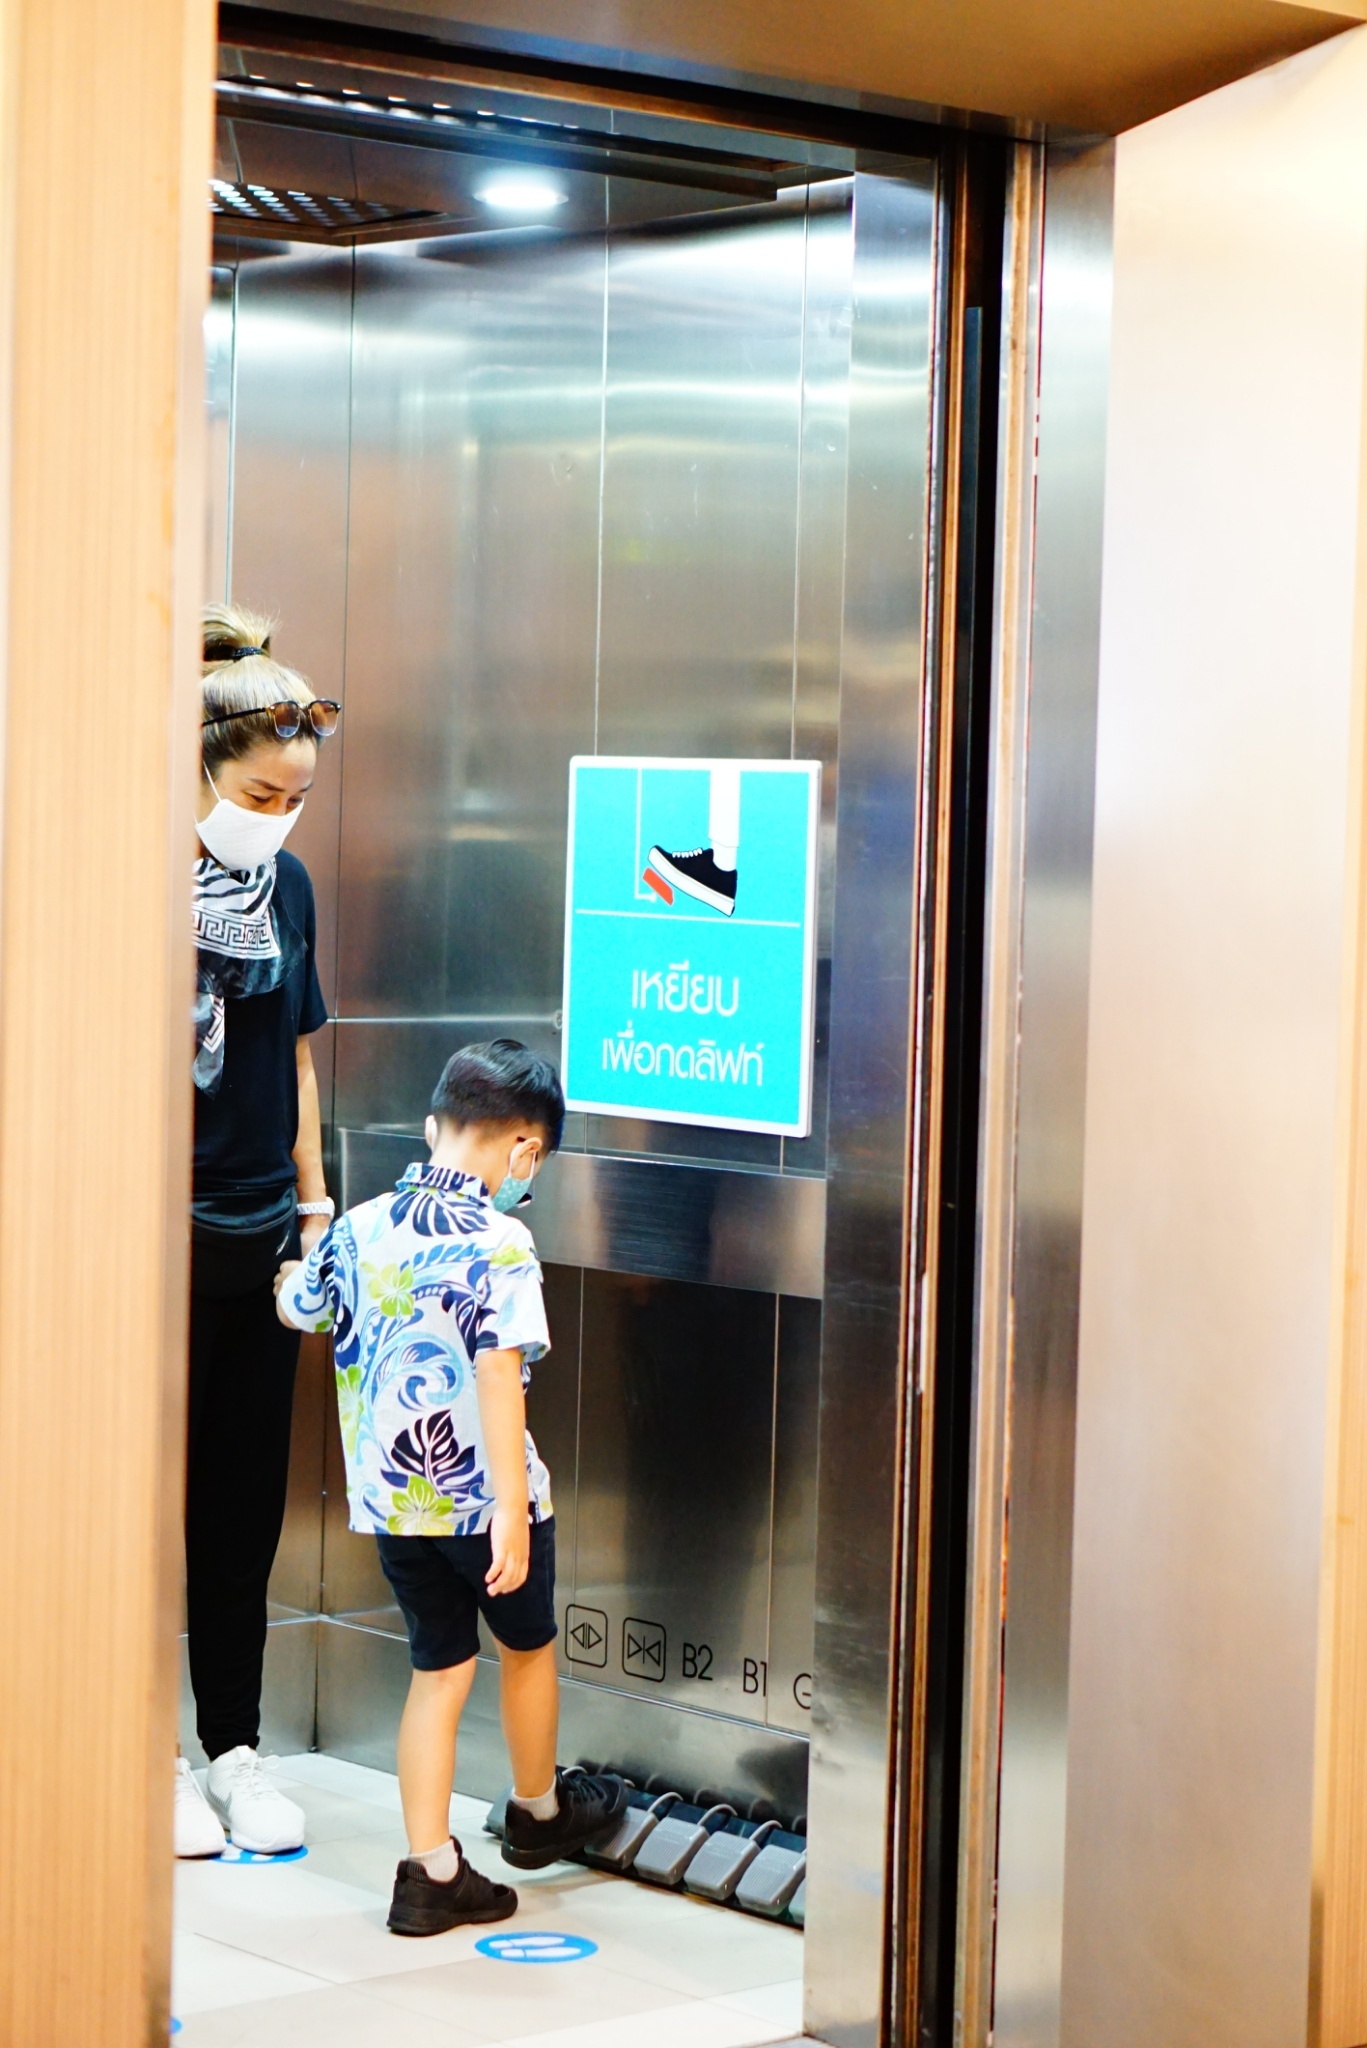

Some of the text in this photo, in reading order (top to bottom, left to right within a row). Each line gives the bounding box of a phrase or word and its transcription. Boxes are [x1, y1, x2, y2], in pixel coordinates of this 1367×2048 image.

[632, 960, 740, 1017] เหยียบ
[602, 1020, 765, 1087] เพื่อกดลิฟท์
[682, 1642, 713, 1681] B2
[743, 1657, 768, 1697] B1
